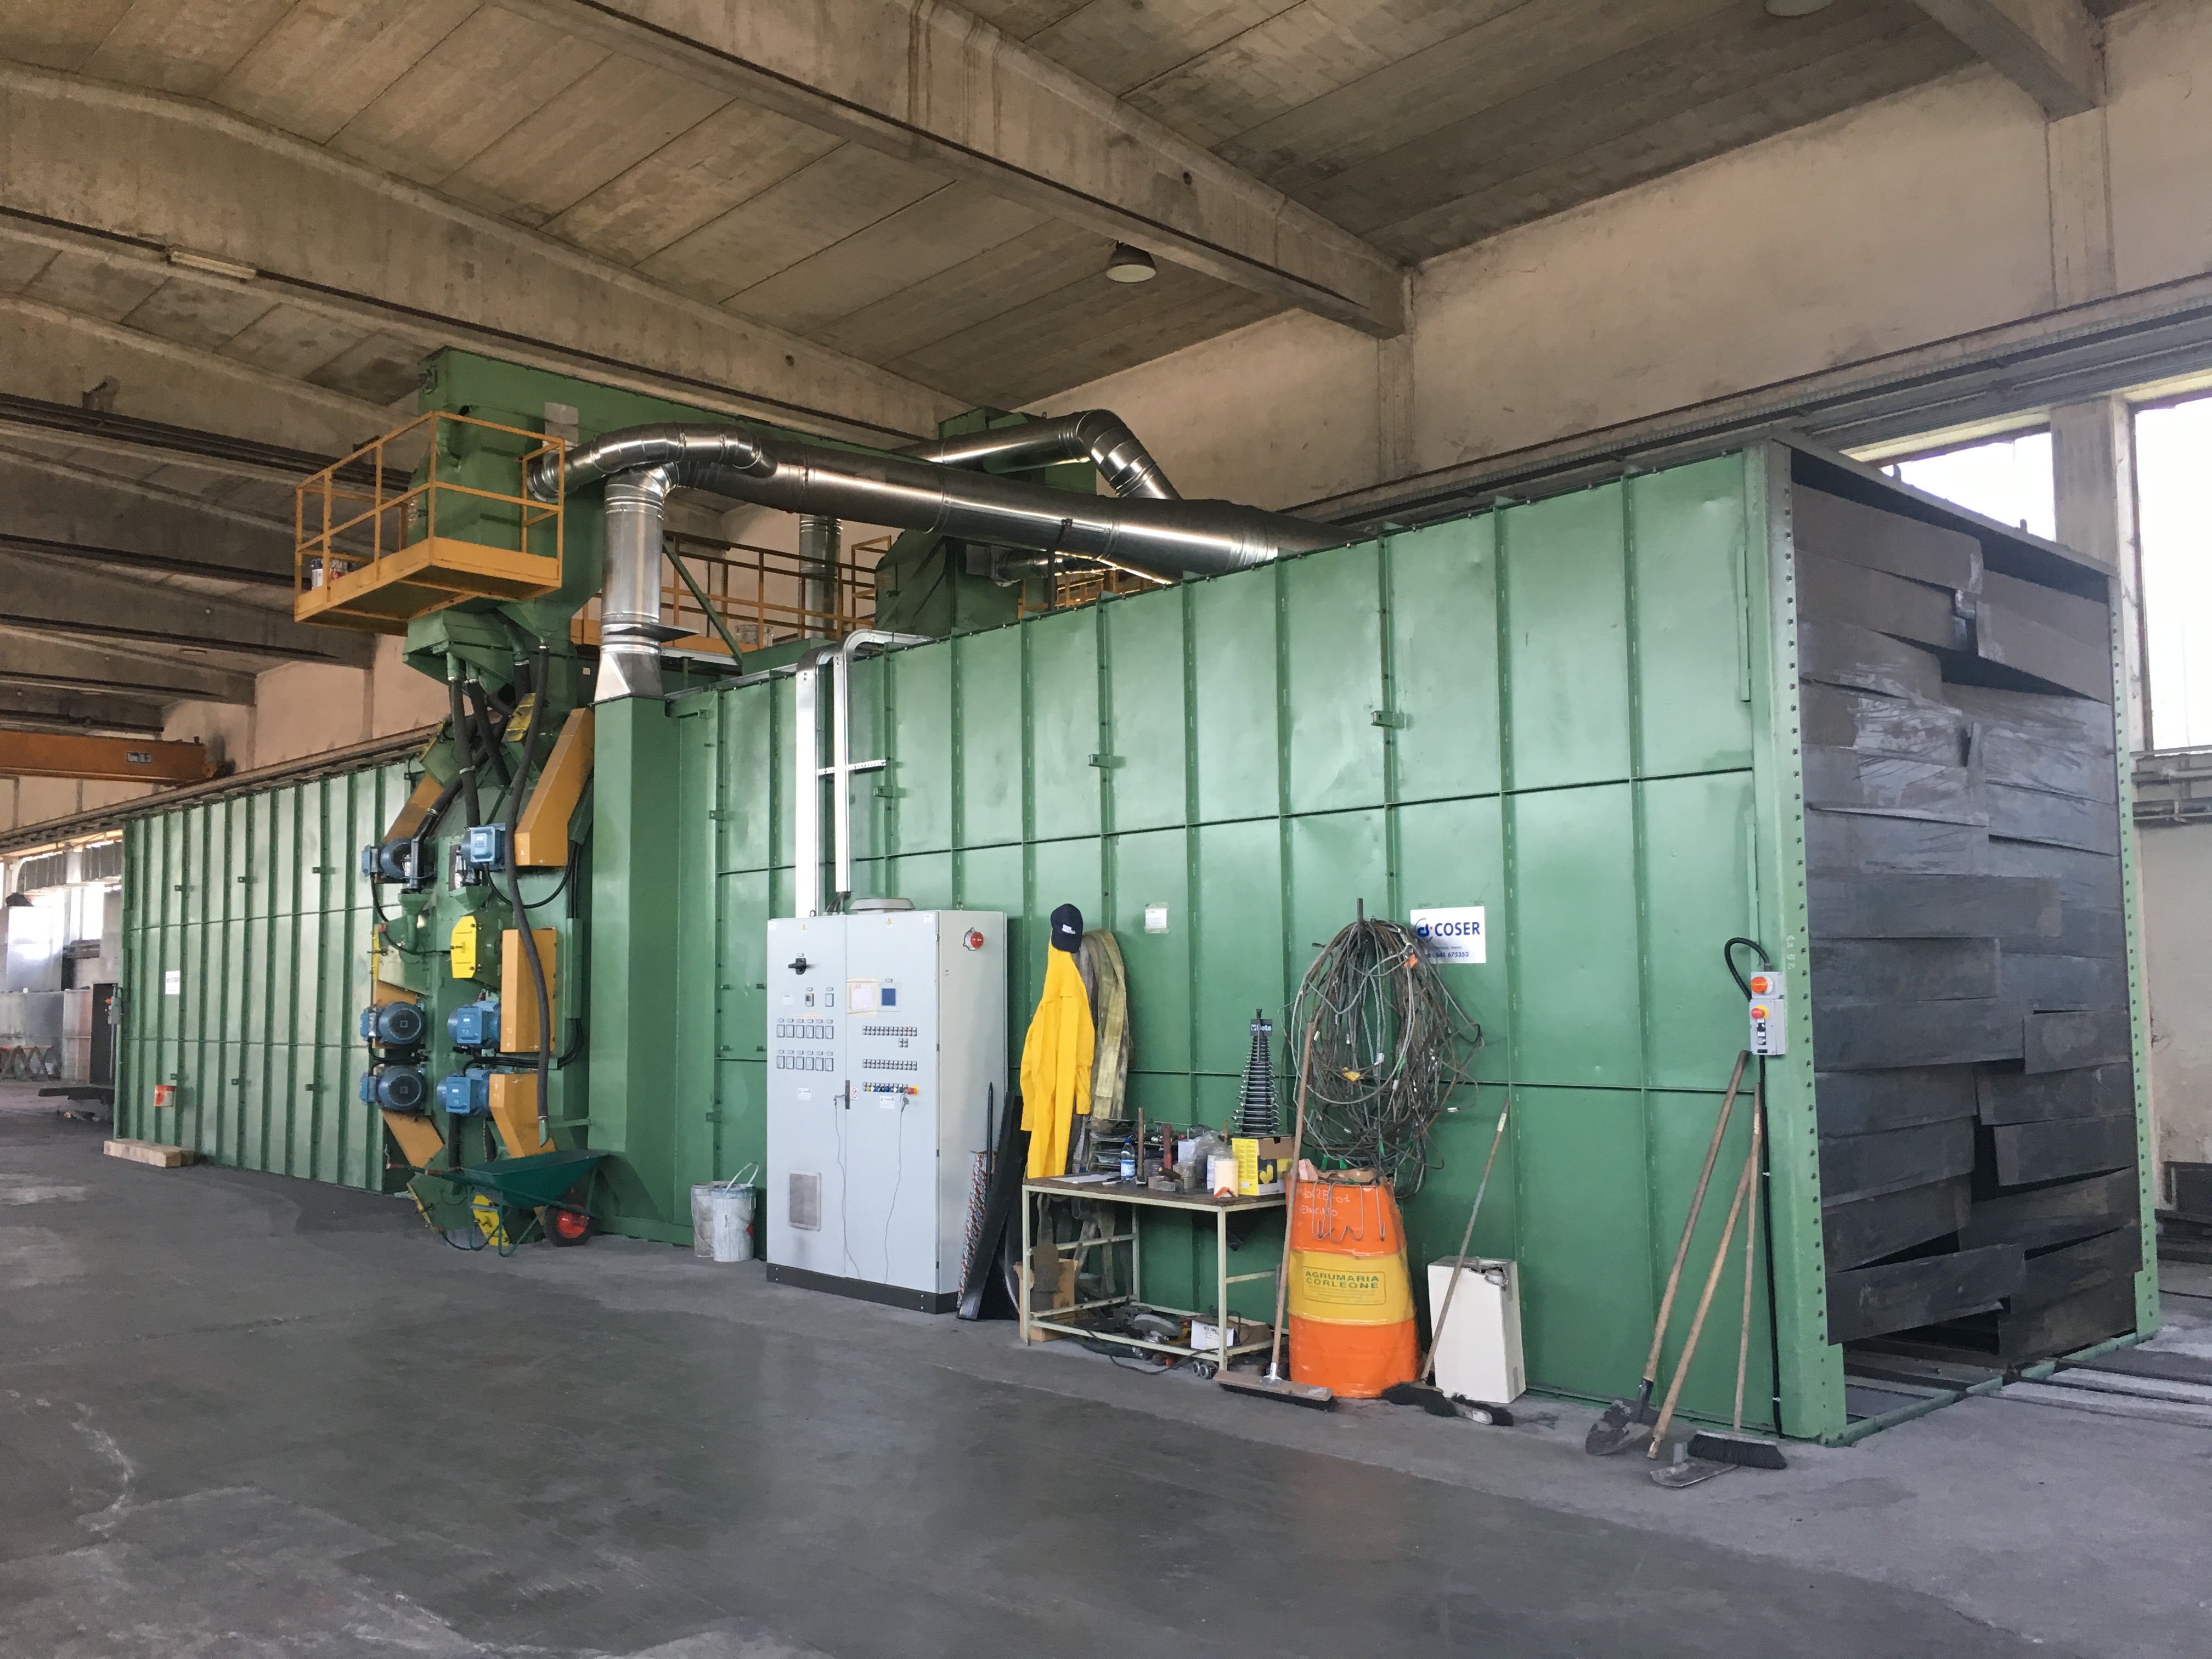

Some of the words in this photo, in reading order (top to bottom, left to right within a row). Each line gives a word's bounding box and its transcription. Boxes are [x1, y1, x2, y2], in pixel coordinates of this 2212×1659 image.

[1435, 922, 1480, 936] COSER
[1306, 1271, 1379, 1282] AGRUMARIA
[1306, 1278, 1379, 1289] CORLEONE
